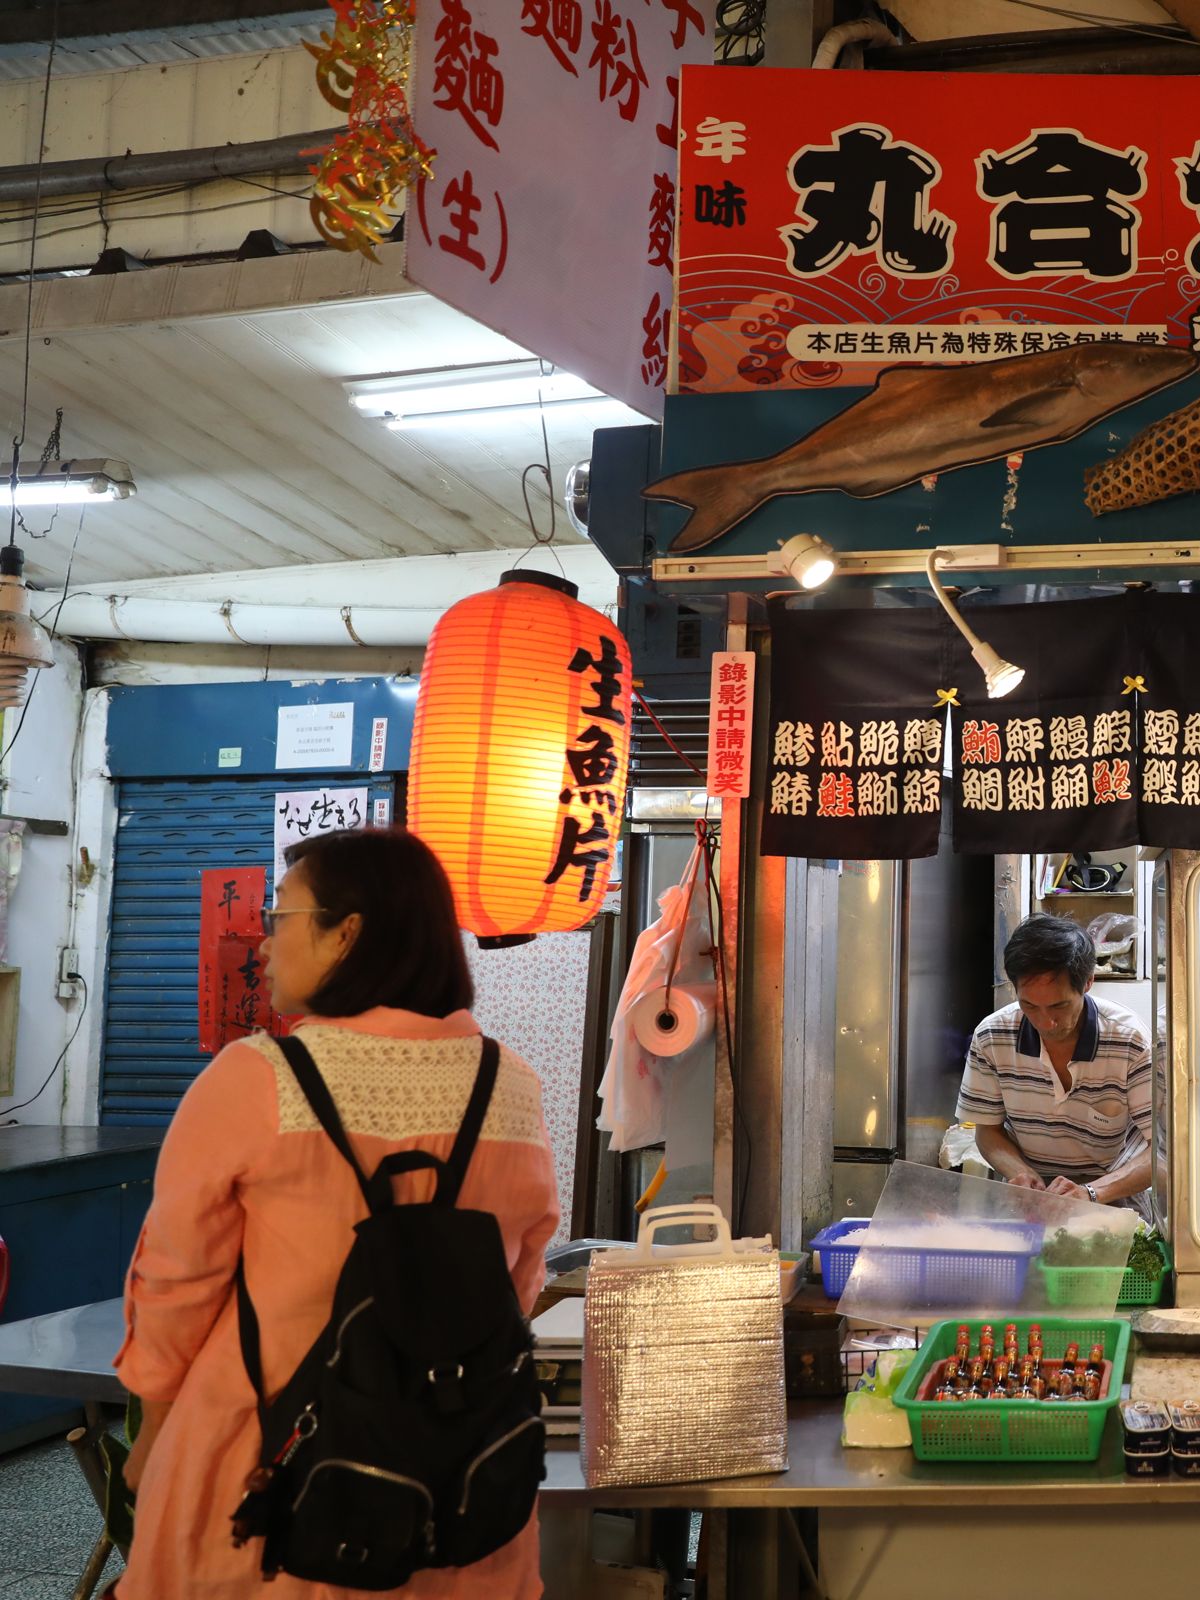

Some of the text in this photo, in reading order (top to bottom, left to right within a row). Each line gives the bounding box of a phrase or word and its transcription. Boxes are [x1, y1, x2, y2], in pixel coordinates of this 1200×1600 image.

[373, 721, 385, 768] 錄影中請微笑
[544, 635, 626, 902] 生魚片
[714, 662, 747, 794] 錄影中請微笑
